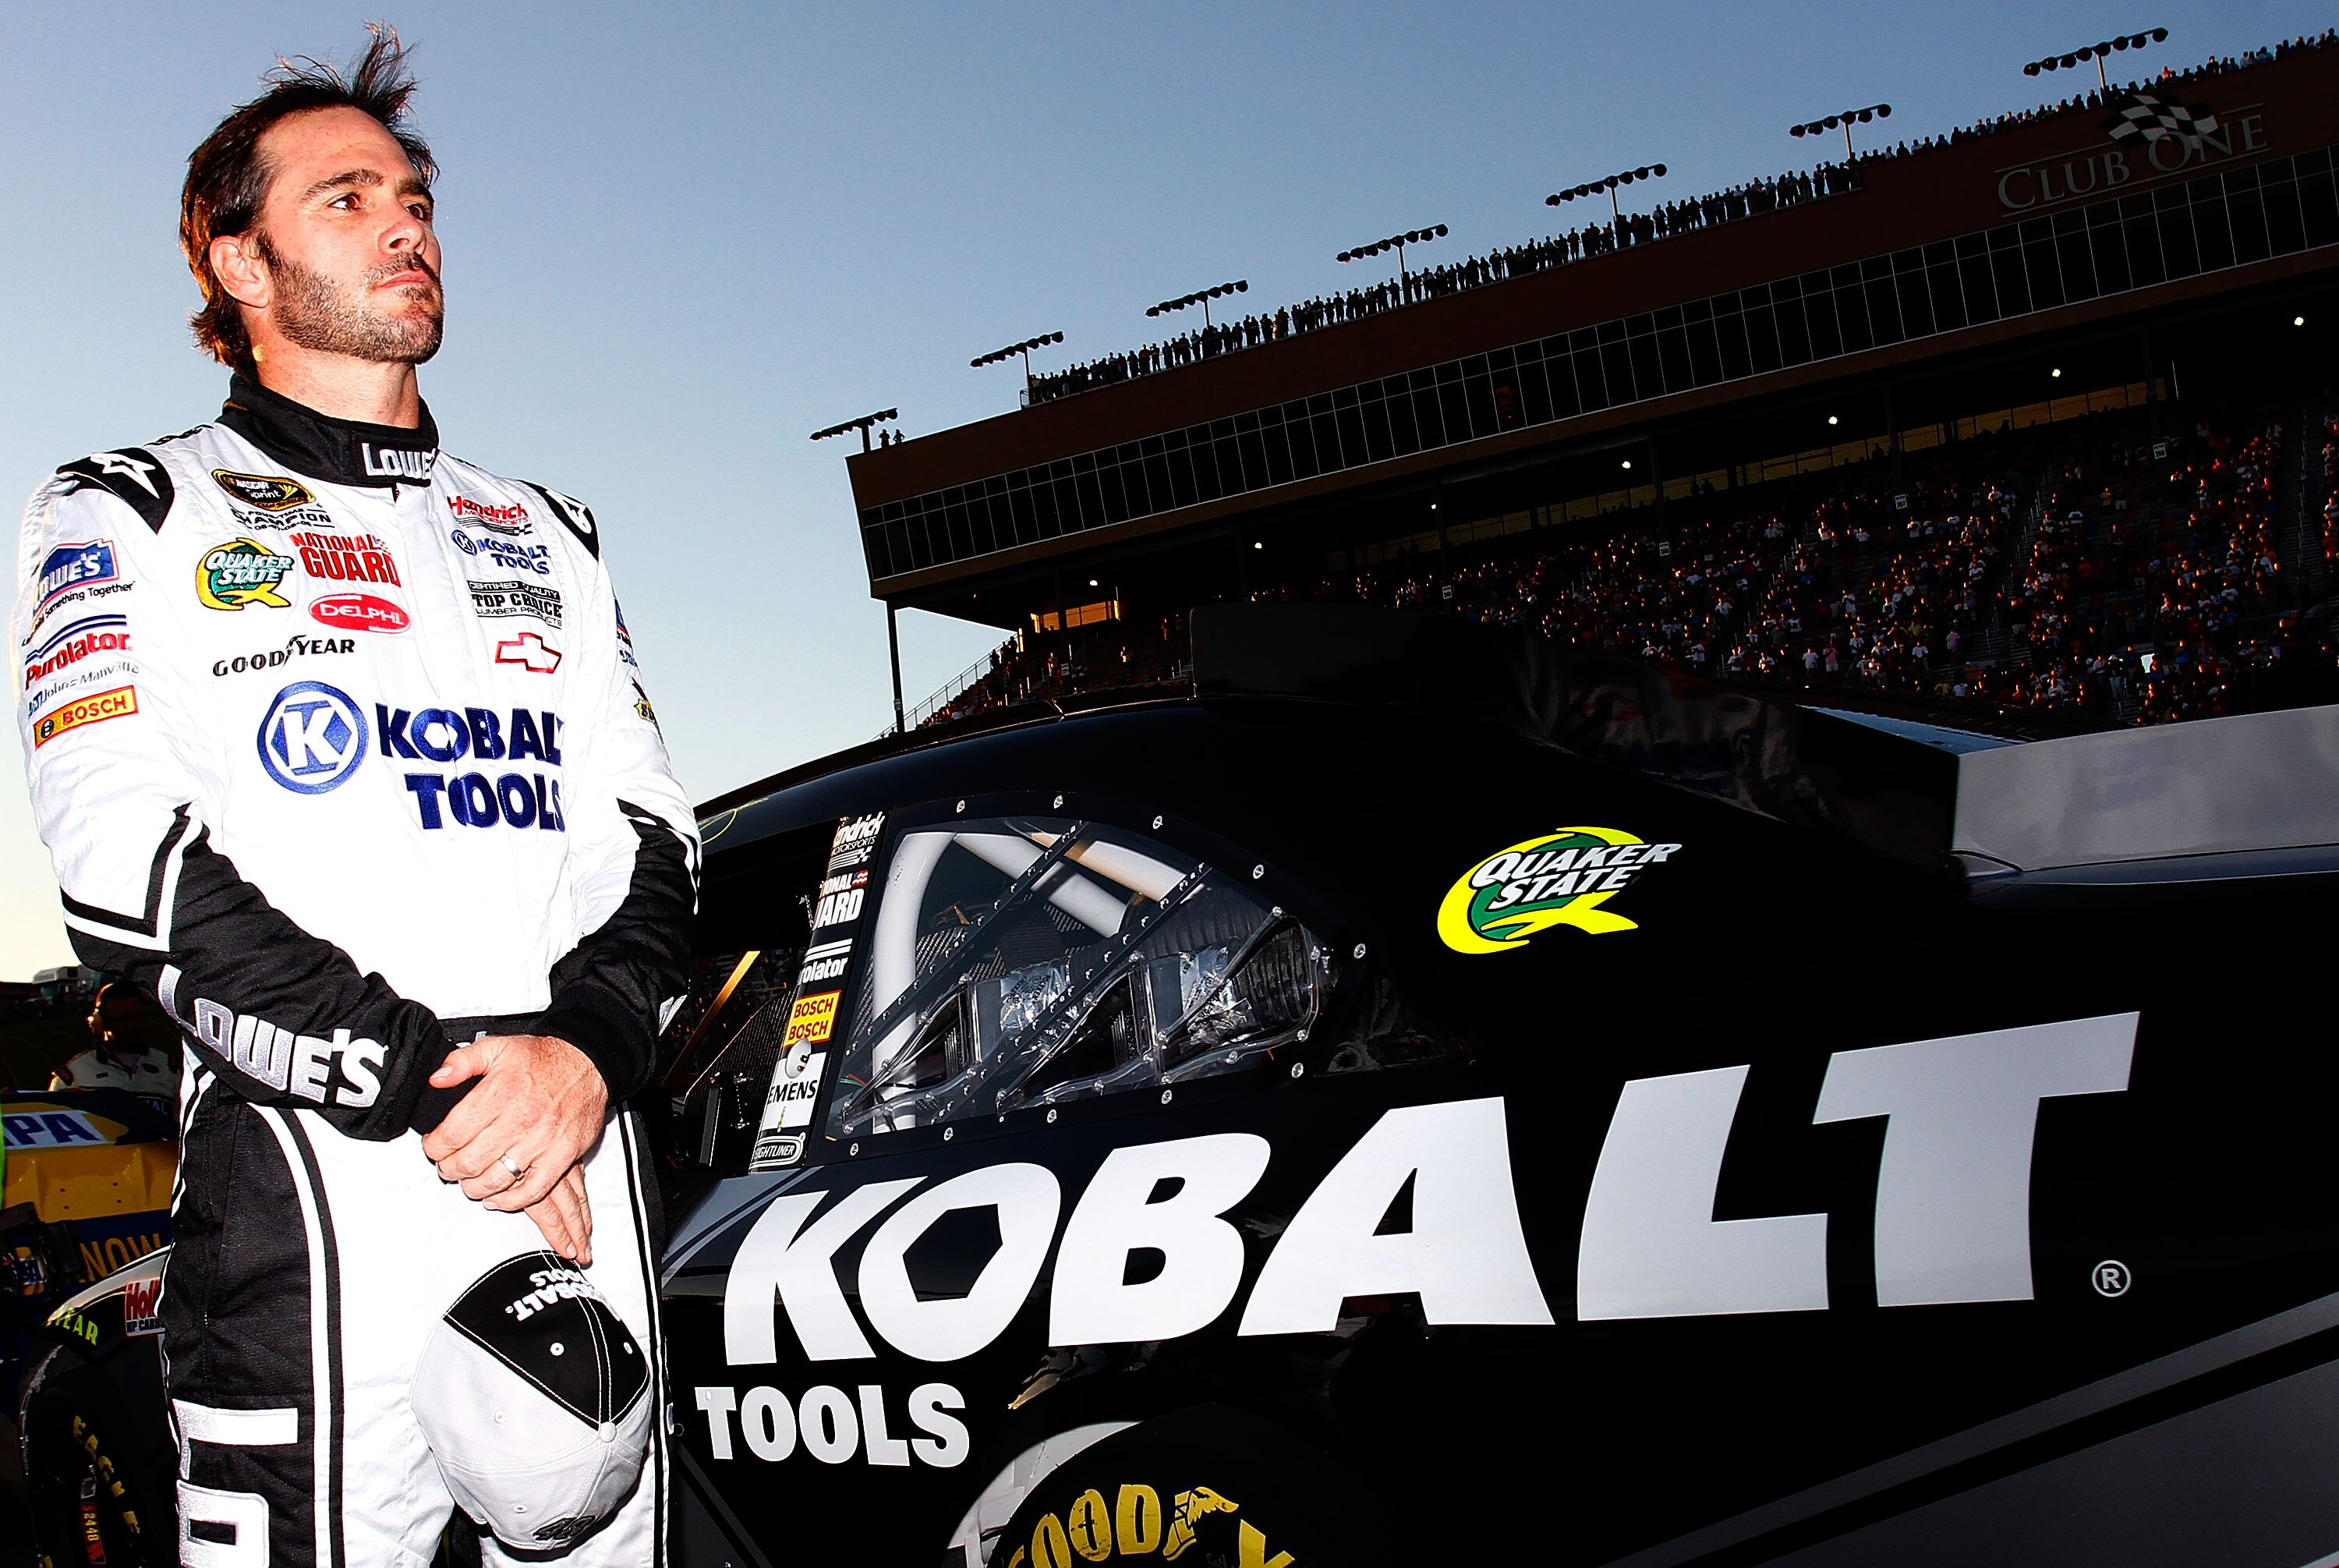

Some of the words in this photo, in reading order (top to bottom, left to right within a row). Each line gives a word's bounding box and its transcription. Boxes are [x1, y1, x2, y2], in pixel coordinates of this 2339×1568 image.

[1998, 149, 2130, 209] CLUB
[2148, 114, 2267, 172] ONE
[235, 479, 271, 490] NASCAR
[246, 489, 281, 500] Sprint
[447, 495, 529, 520] Hendrick
[464, 509, 529, 526] MOTORSPORTS
[288, 532, 378, 552] NATIONAL
[476, 538, 551, 560] KOBALT
[205, 549, 295, 571] QUAKER
[299, 546, 402, 588] GUARD
[490, 553, 550, 575] TOOLS
[218, 568, 281, 585] STATE
[45, 590, 85, 618] Something
[87, 583, 133, 598] Together
[471, 593, 505, 607] TOP
[510, 593, 563, 618] CHOICE
[476, 607, 517, 615] LUMBER
[320, 603, 405, 625] DELPHI
[26, 632, 131, 691] Purolator
[62, 694, 127, 726] BOSCH
[375, 703, 564, 766] KOBAL
[832, 835, 877, 855] OTORSPORTS
[1471, 843, 1683, 888] QUAKER
[1488, 865, 1644, 910] STATE
[794, 997, 834, 1019] BOSCH
[157, 964, 390, 1108] LOWE'S
[788, 1020, 829, 1041] BOSCH
[2, 1113, 99, 1146] PA
[724, 1011, 2139, 1366] KOBALT
[695, 1382, 970, 1469] TOOLS
